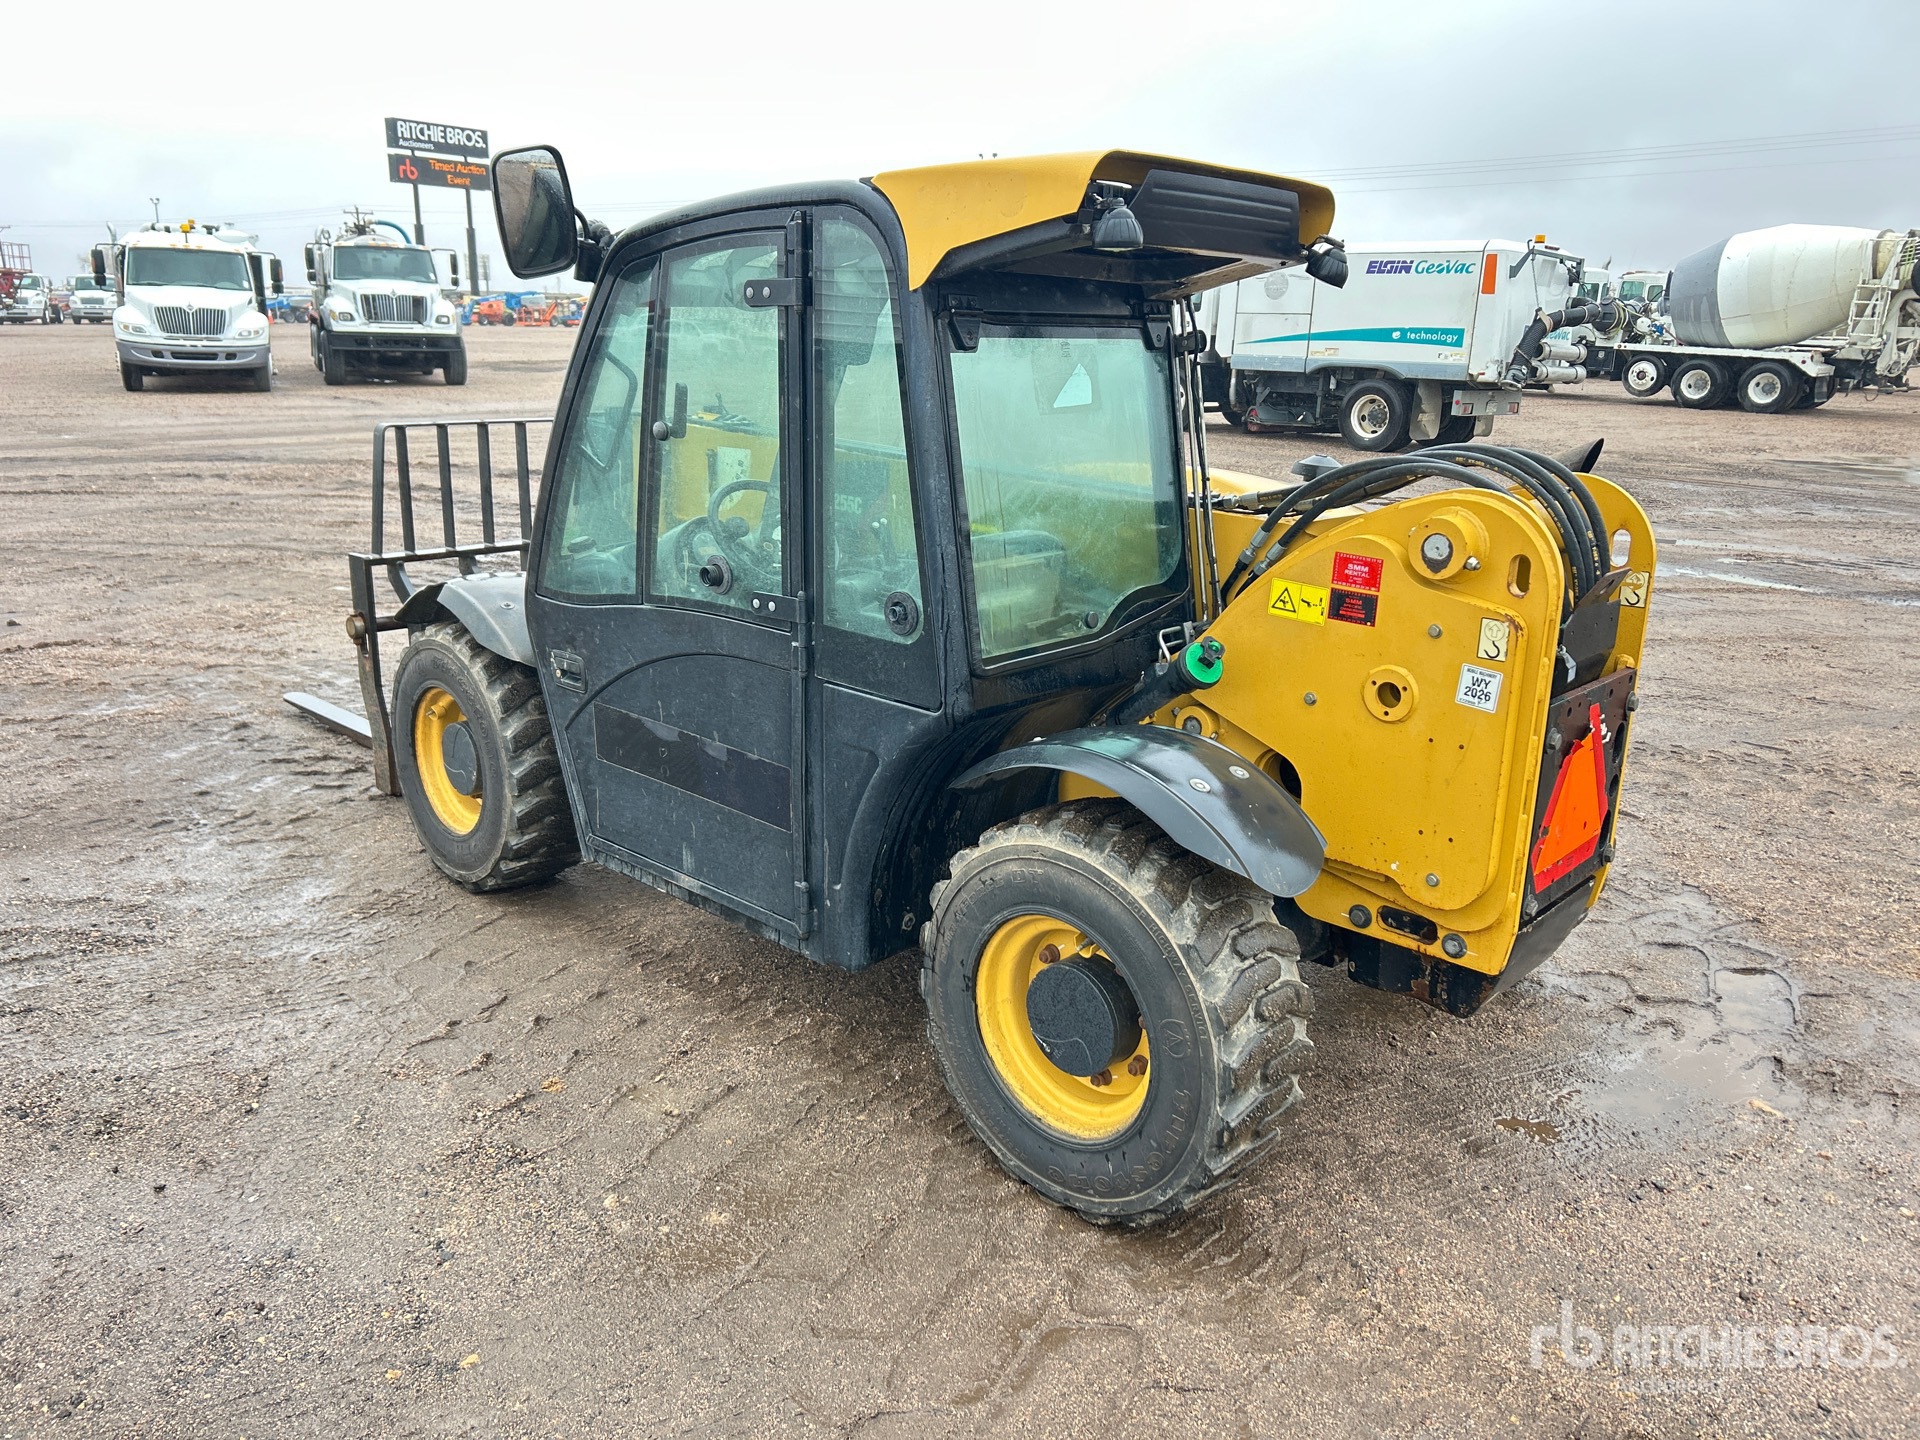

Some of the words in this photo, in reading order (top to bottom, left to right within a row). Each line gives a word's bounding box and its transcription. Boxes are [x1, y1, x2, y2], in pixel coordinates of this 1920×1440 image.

[397, 121, 445, 143] RITCHIE
[446, 127, 486, 148] BROS.
[399, 139, 434, 150] Auctioneers
[429, 160, 455, 172] Timed
[456, 162, 486, 175] Auction
[447, 175, 471, 186] Event
[1366, 260, 1414, 274] ELGIN
[1414, 260, 1476, 274] GeoVac
[1407, 331, 1458, 343] technology
[1344, 569, 1370, 578] RENTAL
[1347, 563, 1369, 572] SMM
[1471, 676, 1492, 690] WY
[1464, 686, 1492, 702] 2026
[1150, 922, 1187, 977] HIGHWAY
